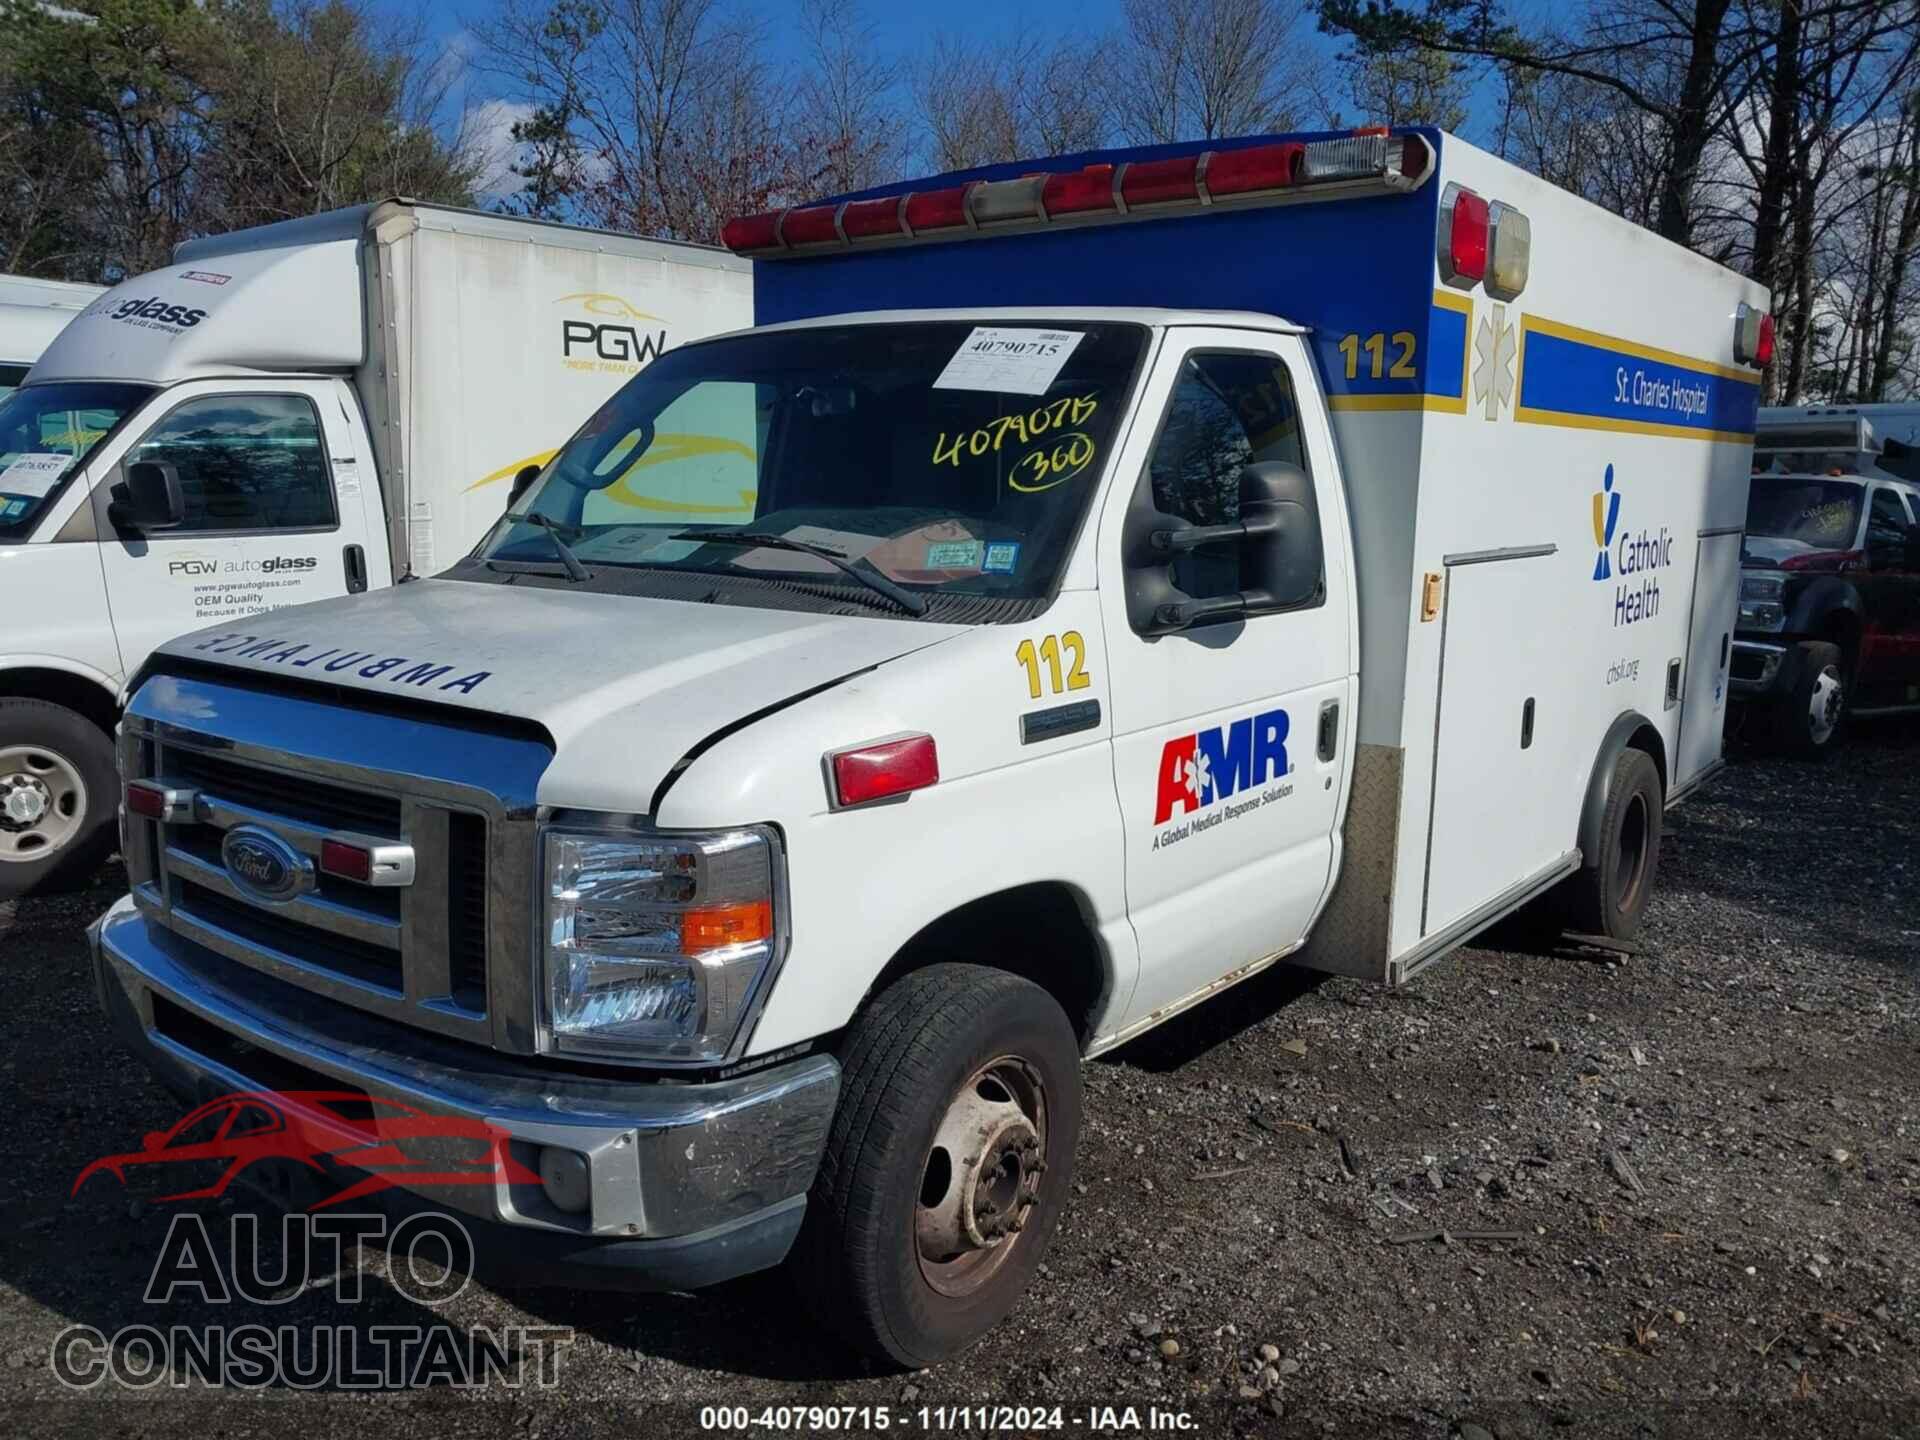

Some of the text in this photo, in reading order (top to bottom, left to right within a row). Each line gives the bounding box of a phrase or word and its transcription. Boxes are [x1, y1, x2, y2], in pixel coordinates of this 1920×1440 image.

[90, 297, 210, 327] toglass
[563, 320, 666, 362] PGW
[970, 340, 1061, 357] 40790715
[1339, 331, 1417, 379] 112
[1615, 366, 1710, 421] St. Charles Hospital
[932, 390, 1099, 467] 40790715
[1022, 440, 1091, 481] 360
[169, 556, 318, 575] PGW autoglass
[1618, 527, 1673, 576] Catholic
[193, 578, 301, 593] www.pgwautoglass.com
[194, 593, 264, 607] OEM Quality
[1614, 577, 1660, 628] Health
[196, 606, 236, 618] Because
[1016, 630, 1091, 699] 112
[1606, 657, 1641, 686] chsli.org
[1153, 708, 1290, 826] AMR
[1151, 783, 1294, 852] A Global Medical Response Solution
